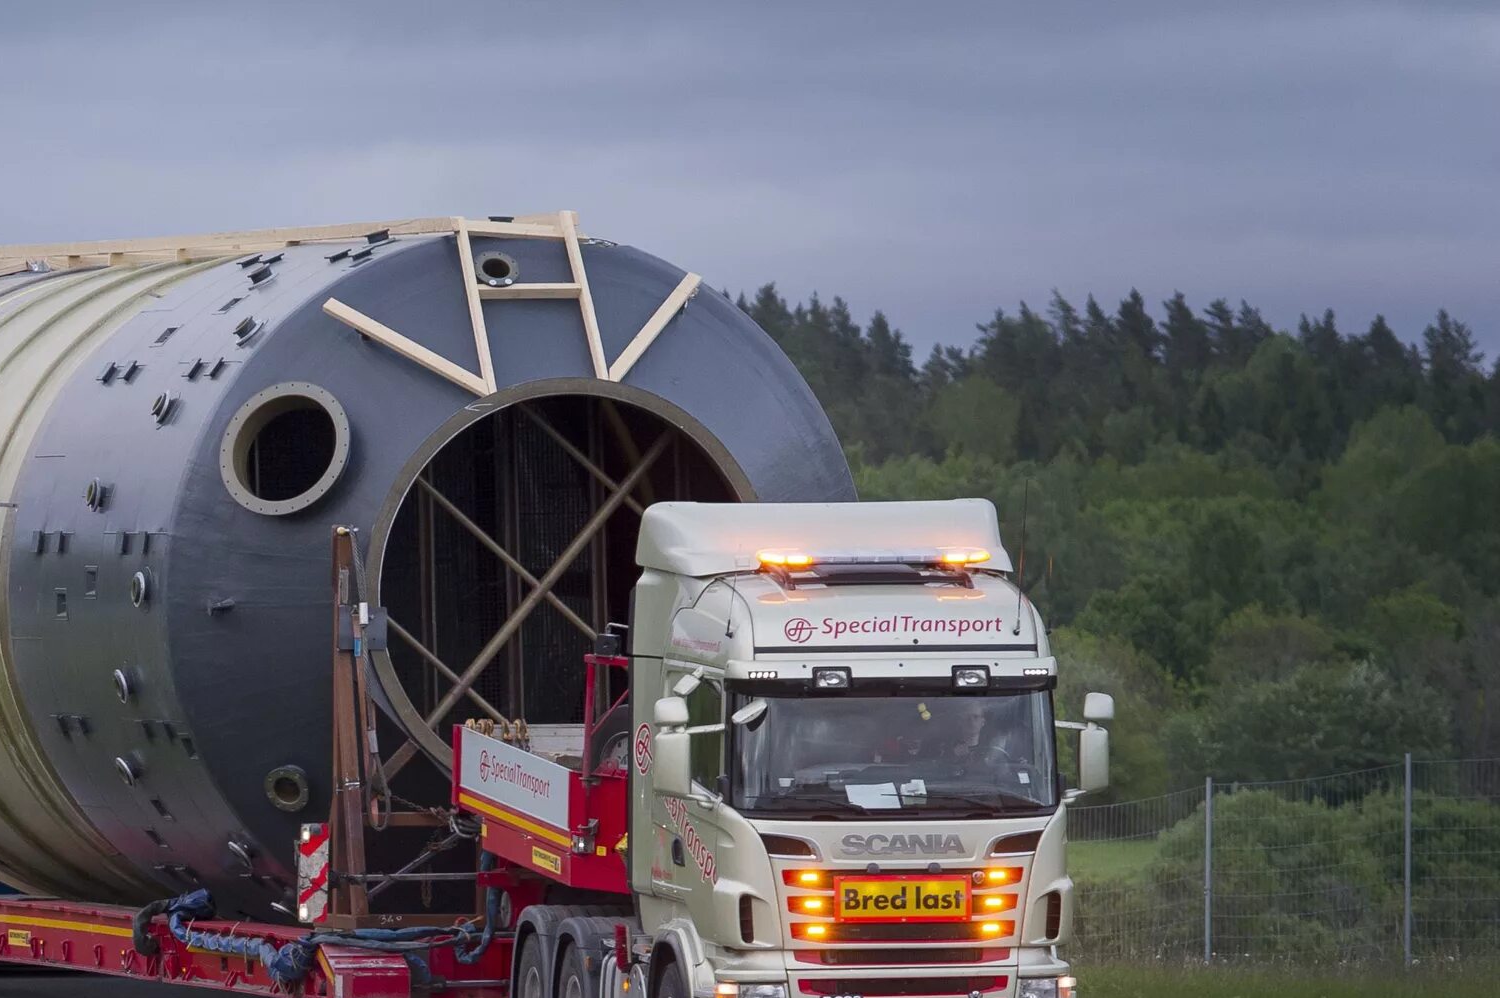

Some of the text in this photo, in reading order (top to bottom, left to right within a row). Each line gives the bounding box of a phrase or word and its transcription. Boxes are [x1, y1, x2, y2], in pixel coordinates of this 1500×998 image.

[840, 834, 966, 856] SCANIA
[844, 886, 963, 910] Bred last
